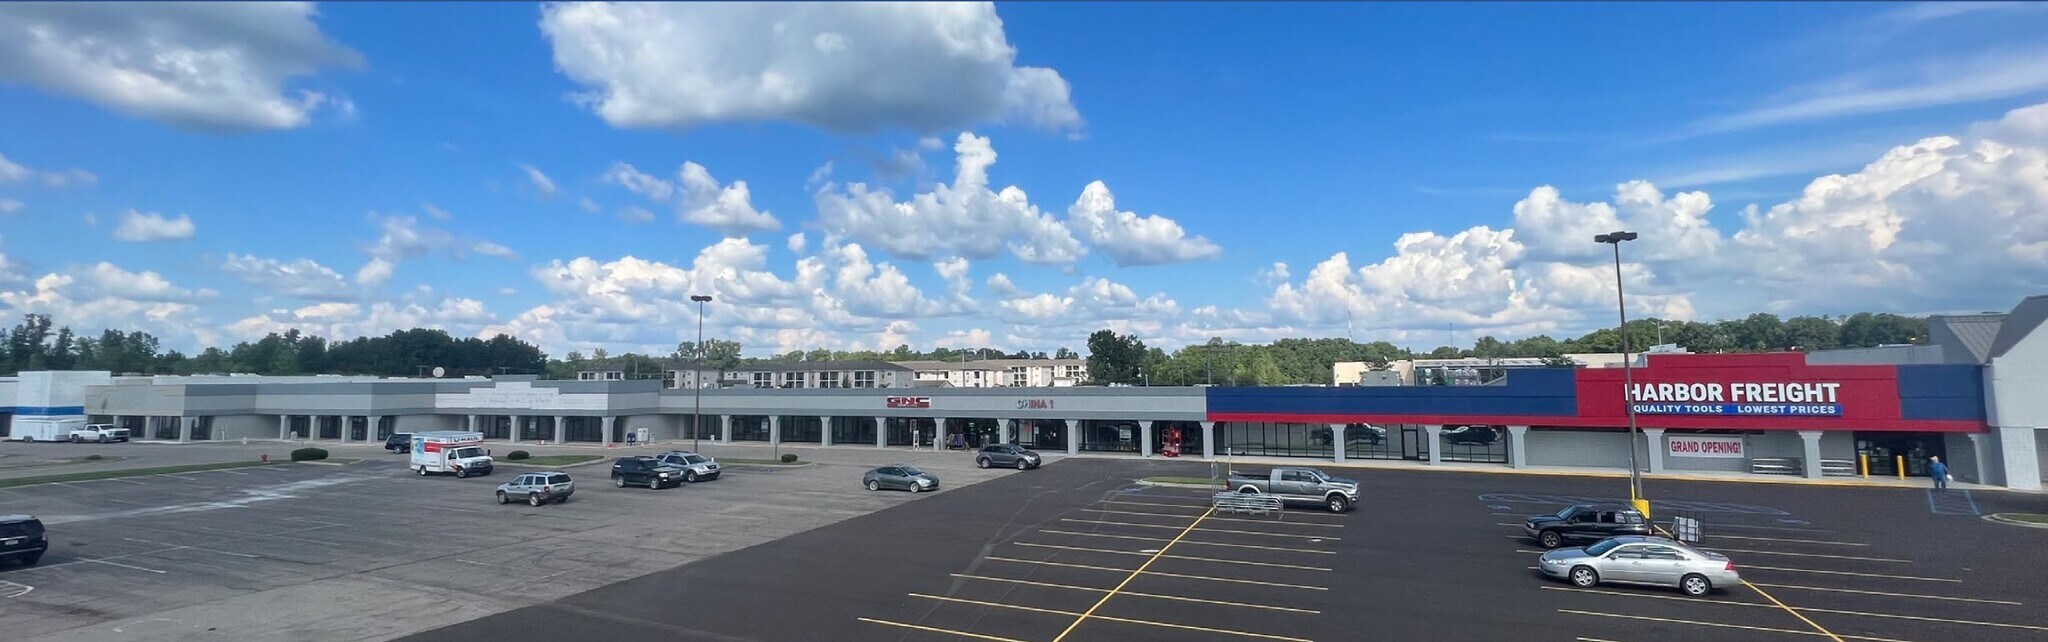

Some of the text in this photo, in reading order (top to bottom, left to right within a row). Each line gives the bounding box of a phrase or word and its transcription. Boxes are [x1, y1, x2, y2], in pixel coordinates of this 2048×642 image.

[1624, 383, 1841, 402] HARBOR FREIGHT
[886, 396, 931, 409] GNC
[1633, 404, 1723, 413] QUALITY TOOLS
[1737, 405, 1836, 414] LOWEST PRICES
[1670, 441, 1742, 454] GRAND OPENING!
